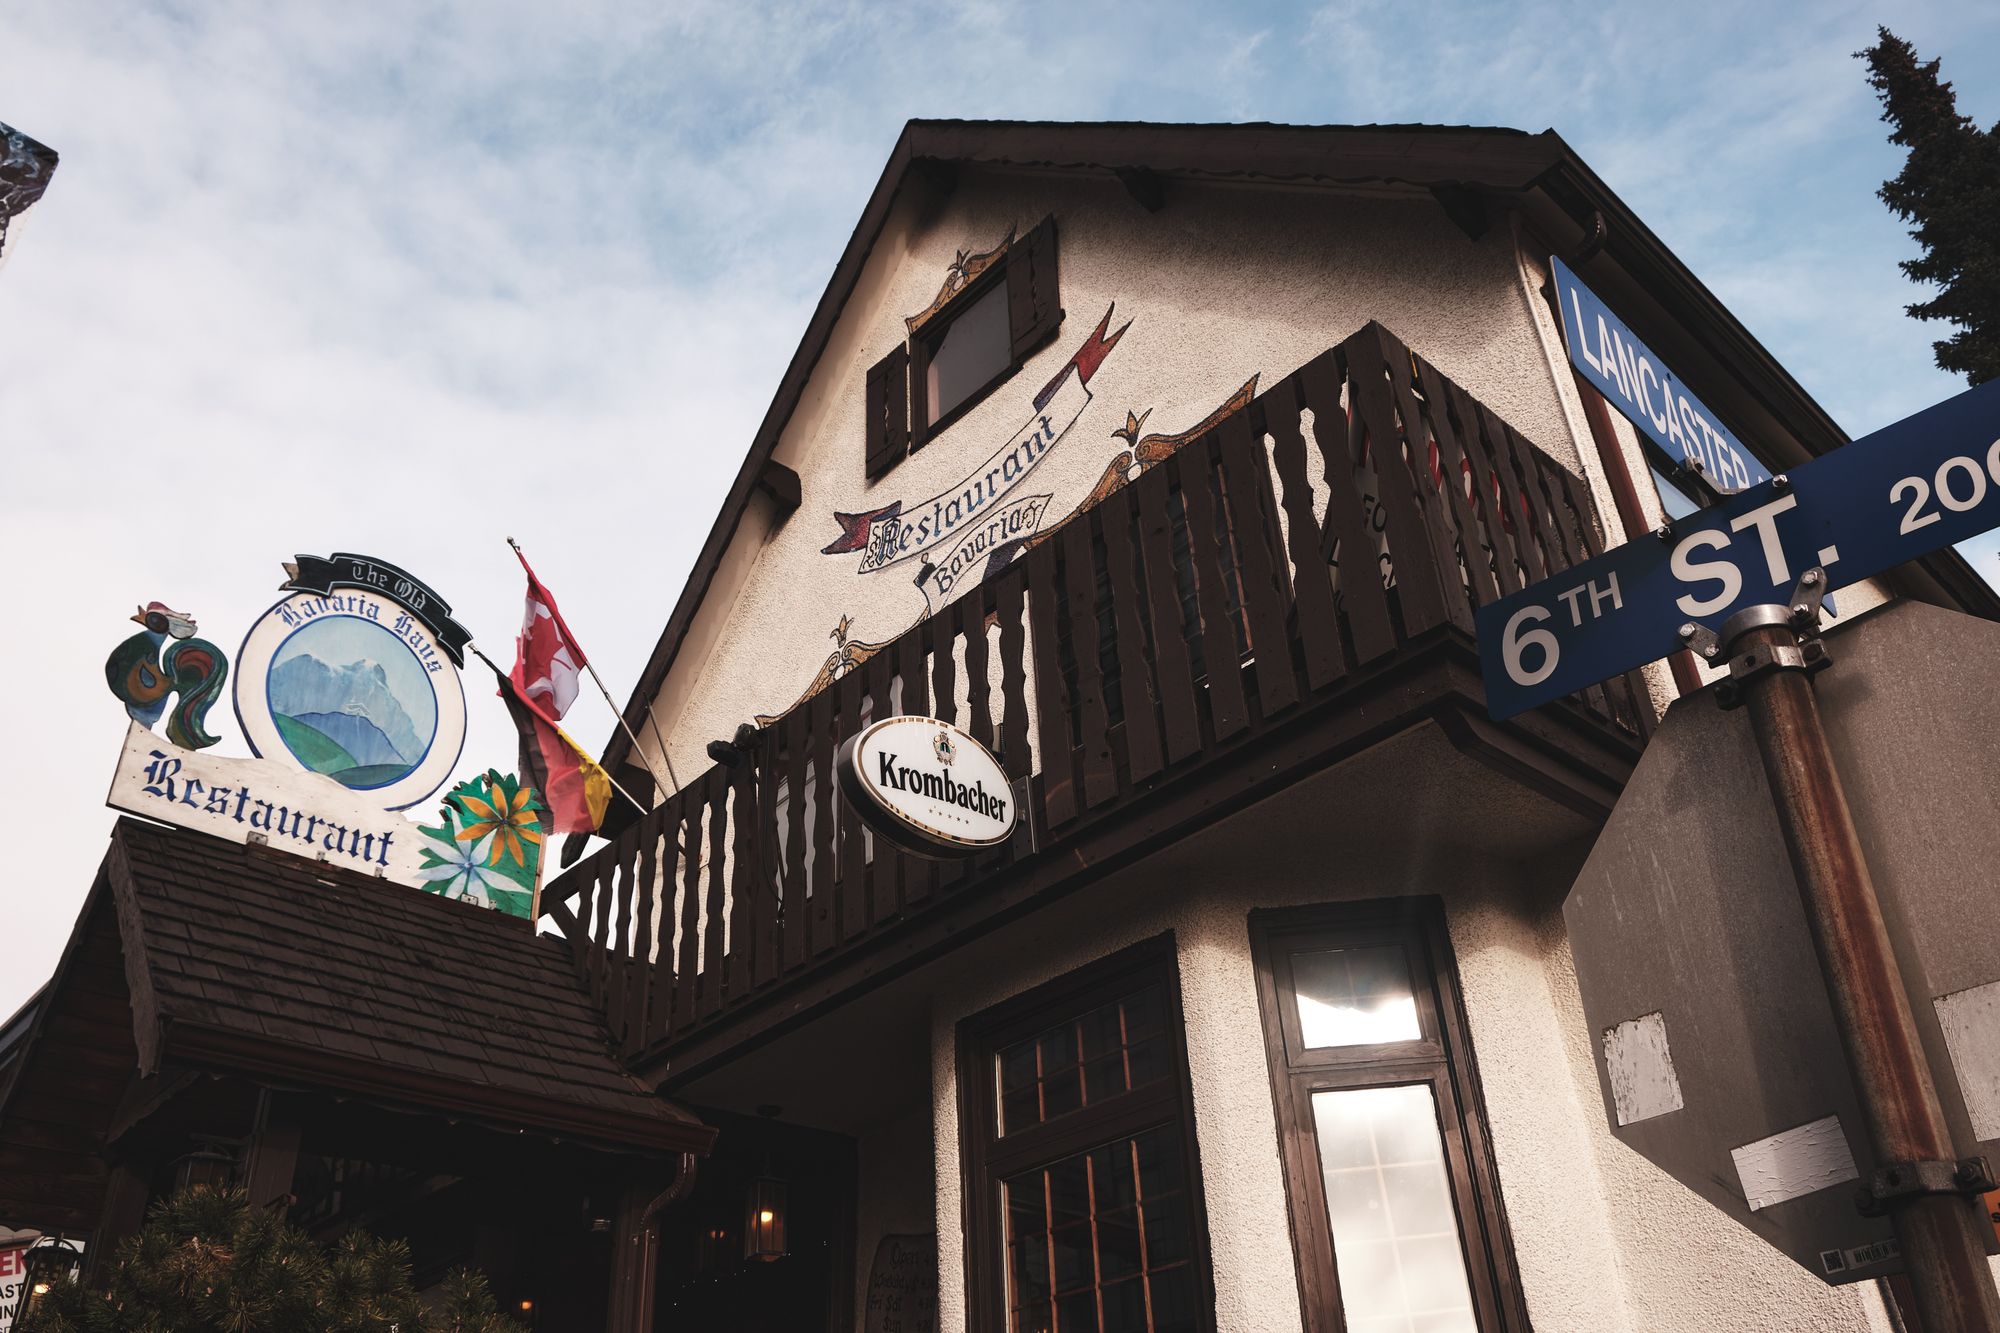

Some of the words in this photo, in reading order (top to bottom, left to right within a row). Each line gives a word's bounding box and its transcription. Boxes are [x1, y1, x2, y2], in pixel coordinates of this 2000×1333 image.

[877, 416, 1056, 566] Restaurant
[351, 560, 388, 587] The
[394, 579, 426, 610] Old
[932, 505, 1023, 596] Bavaria
[1501, 571, 1624, 687] 6TH
[1670, 494, 1840, 617] ST.
[1889, 438, 2000, 536] 20
[274, 594, 381, 629] Bavaria
[393, 610, 443, 673] Haus
[142, 750, 394, 868] Restaurant
[878, 751, 1006, 823] Krombacher
